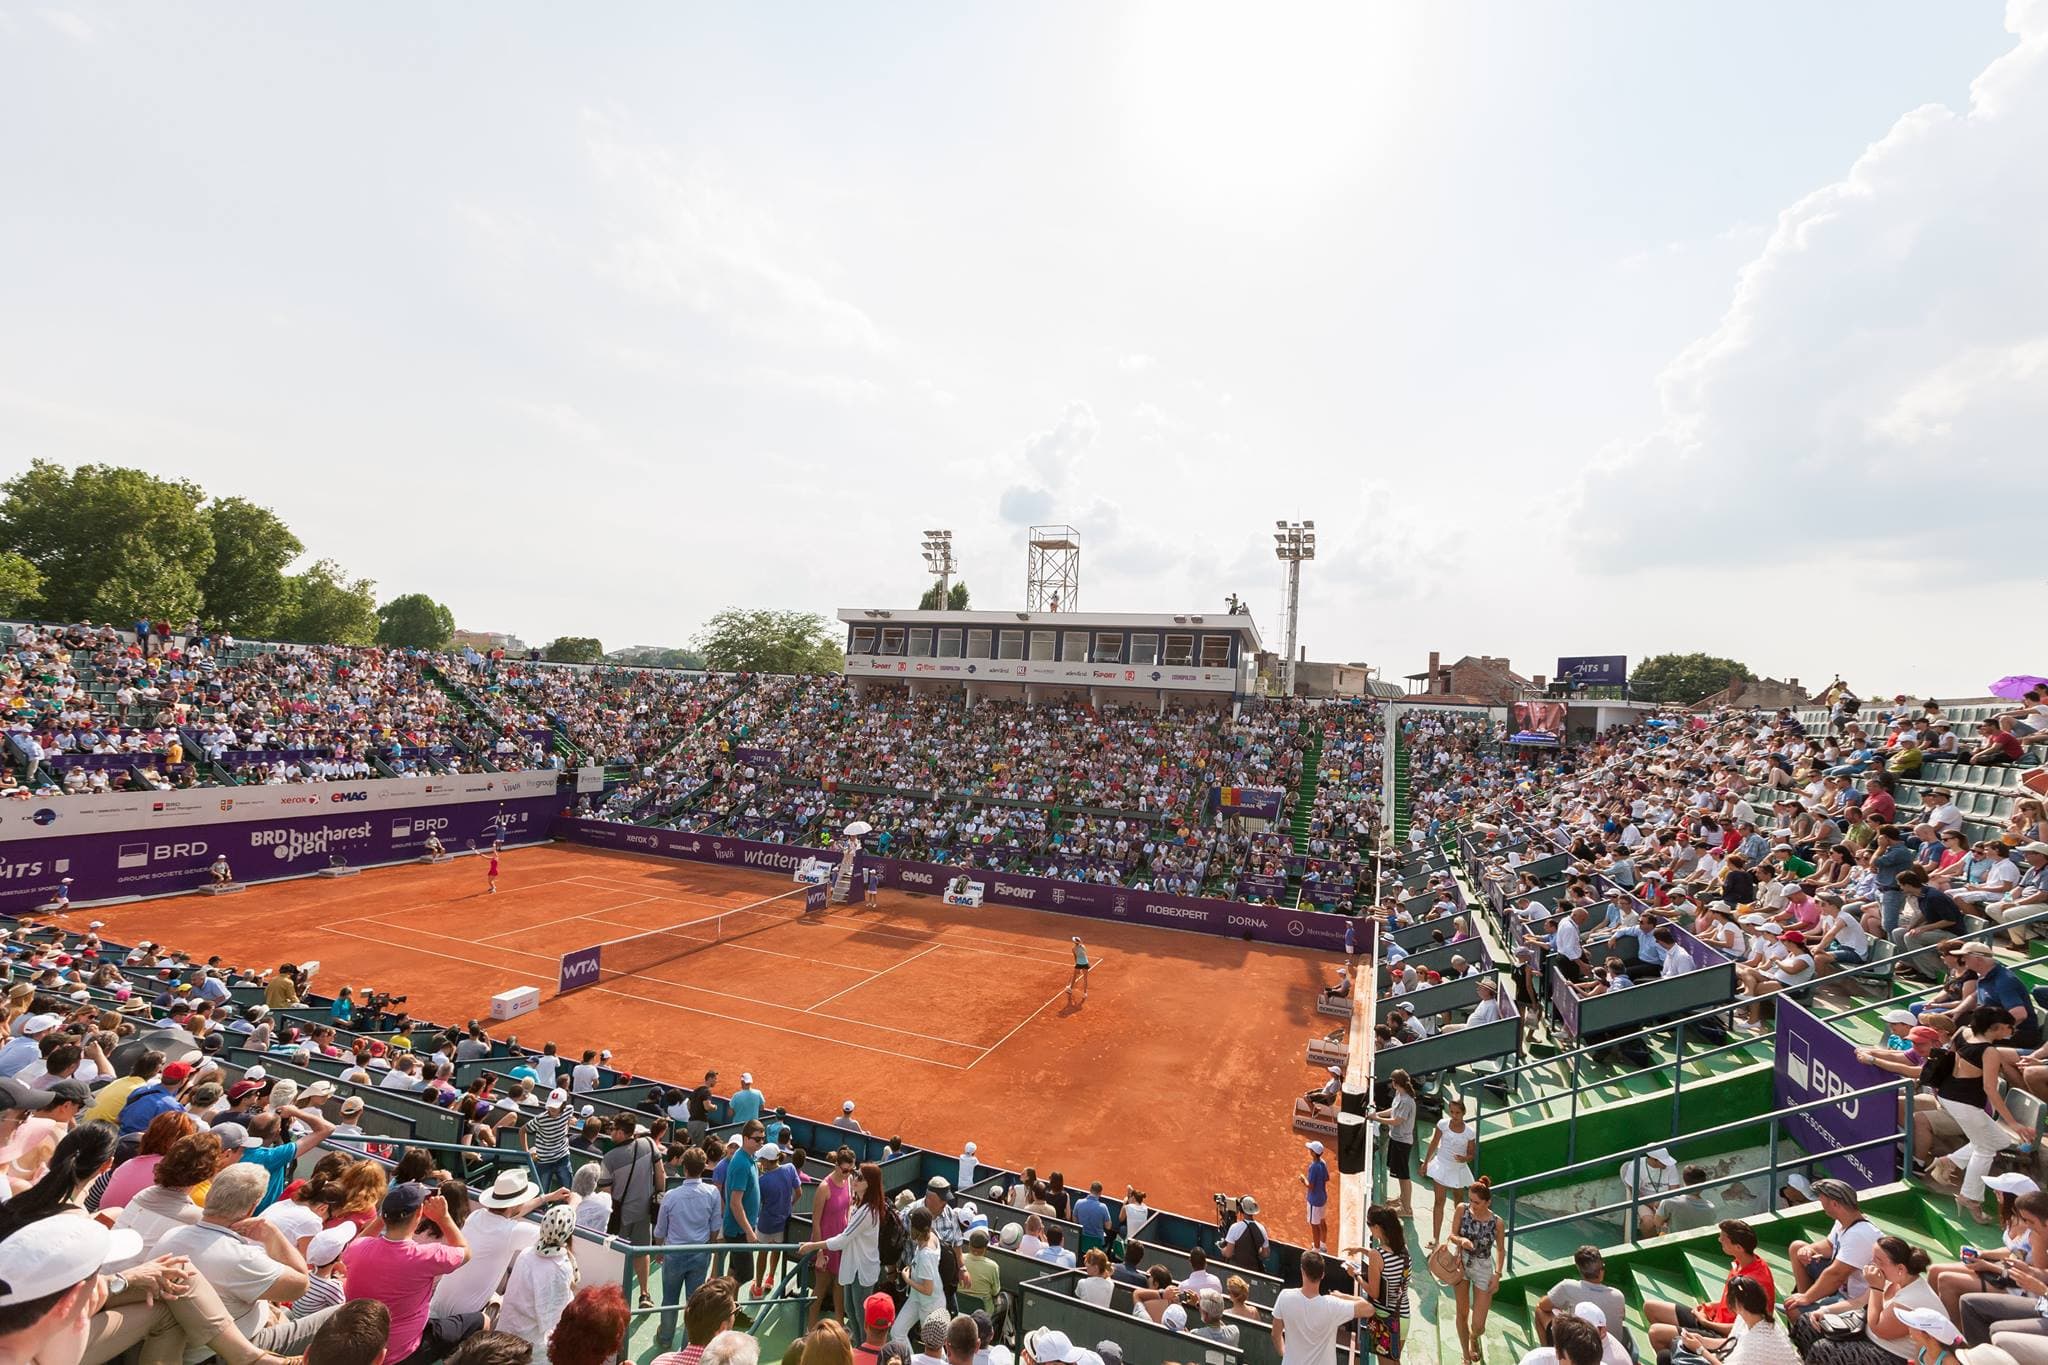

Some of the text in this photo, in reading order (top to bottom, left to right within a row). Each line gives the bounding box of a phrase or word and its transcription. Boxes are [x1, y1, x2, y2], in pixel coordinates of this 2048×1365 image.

[280, 796, 306, 805] xerox
[331, 791, 367, 803] eMAG
[413, 817, 449, 832] BRD
[251, 821, 372, 847] BRD bucharest
[626, 834, 648, 844] xerox
[153, 841, 208, 860] BRD
[118, 873, 150, 883] GROUPE
[151, 870, 183, 879] SOCIETE
[798, 873, 820, 884] eMAG
[901, 870, 933, 885] eMAG
[807, 892, 827, 905] WTA
[948, 895, 973, 906] eMAG
[1145, 904, 1209, 921] MOBEXPERT
[1227, 914, 1268, 929] DORNA
[1306, 927, 1346, 939] Mercedes-Ben
[563, 958, 599, 980] WTA
[1308, 1053, 1345, 1066] MOBEXPERT
[1812, 1057, 1859, 1120] BRD
[1295, 1118, 1338, 1134] MOBEXPERT
